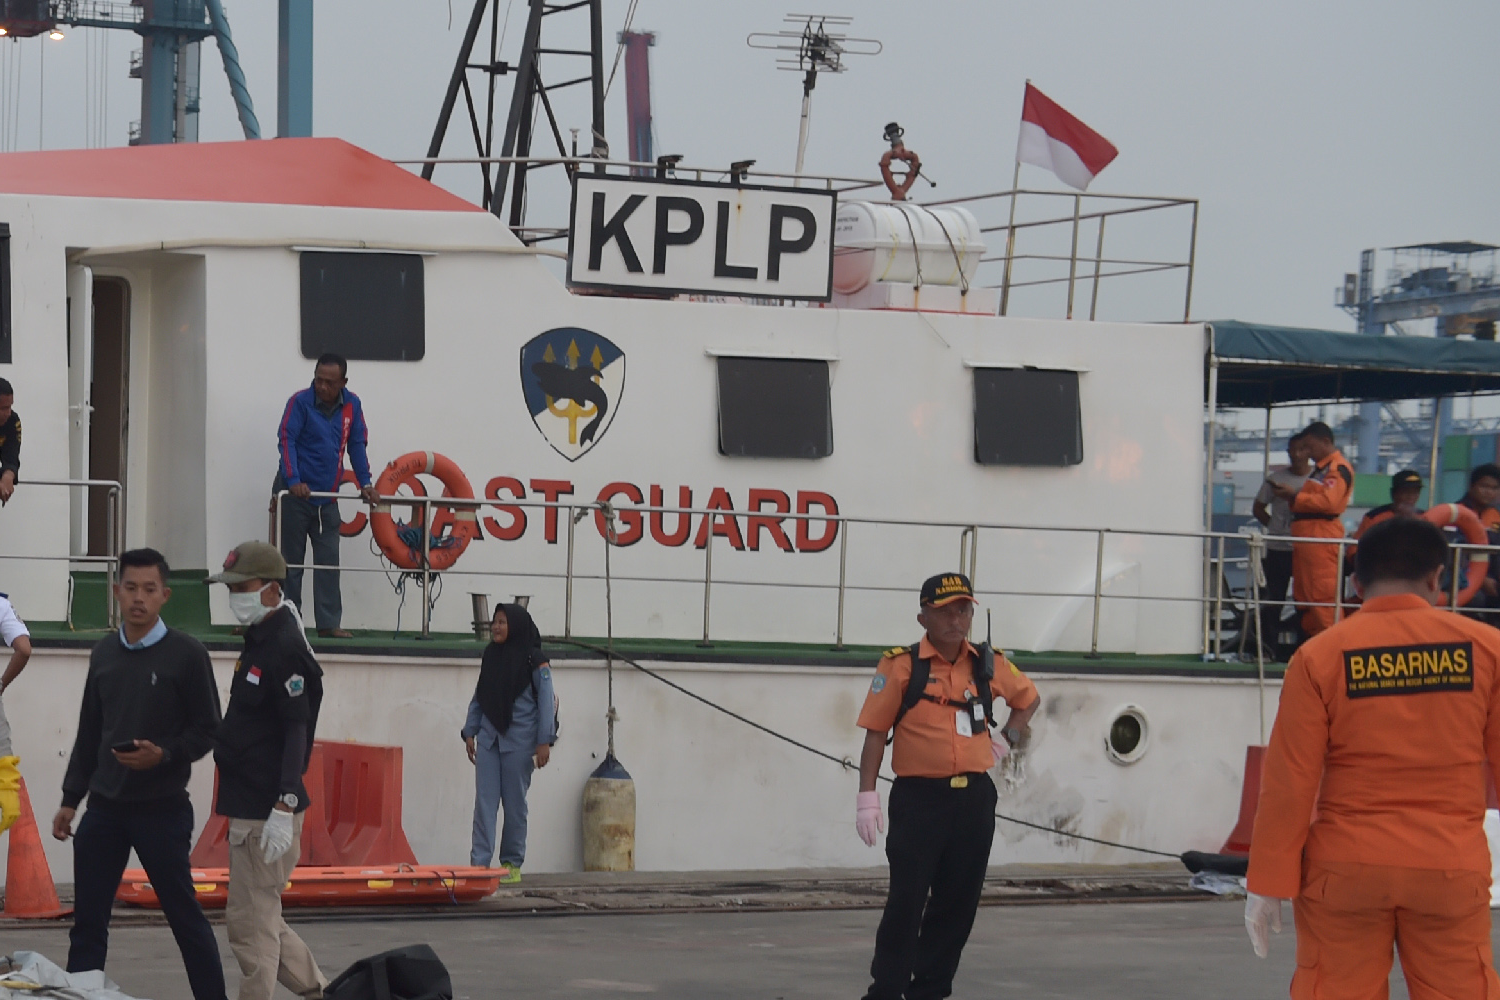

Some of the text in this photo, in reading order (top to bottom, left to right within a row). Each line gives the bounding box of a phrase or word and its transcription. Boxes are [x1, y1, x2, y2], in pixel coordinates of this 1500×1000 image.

[588, 191, 817, 282] KPLP
[594, 481, 840, 553] GUARD
[941, 576, 962, 587] SAR
[1350, 648, 1468, 680] BASARNAS
